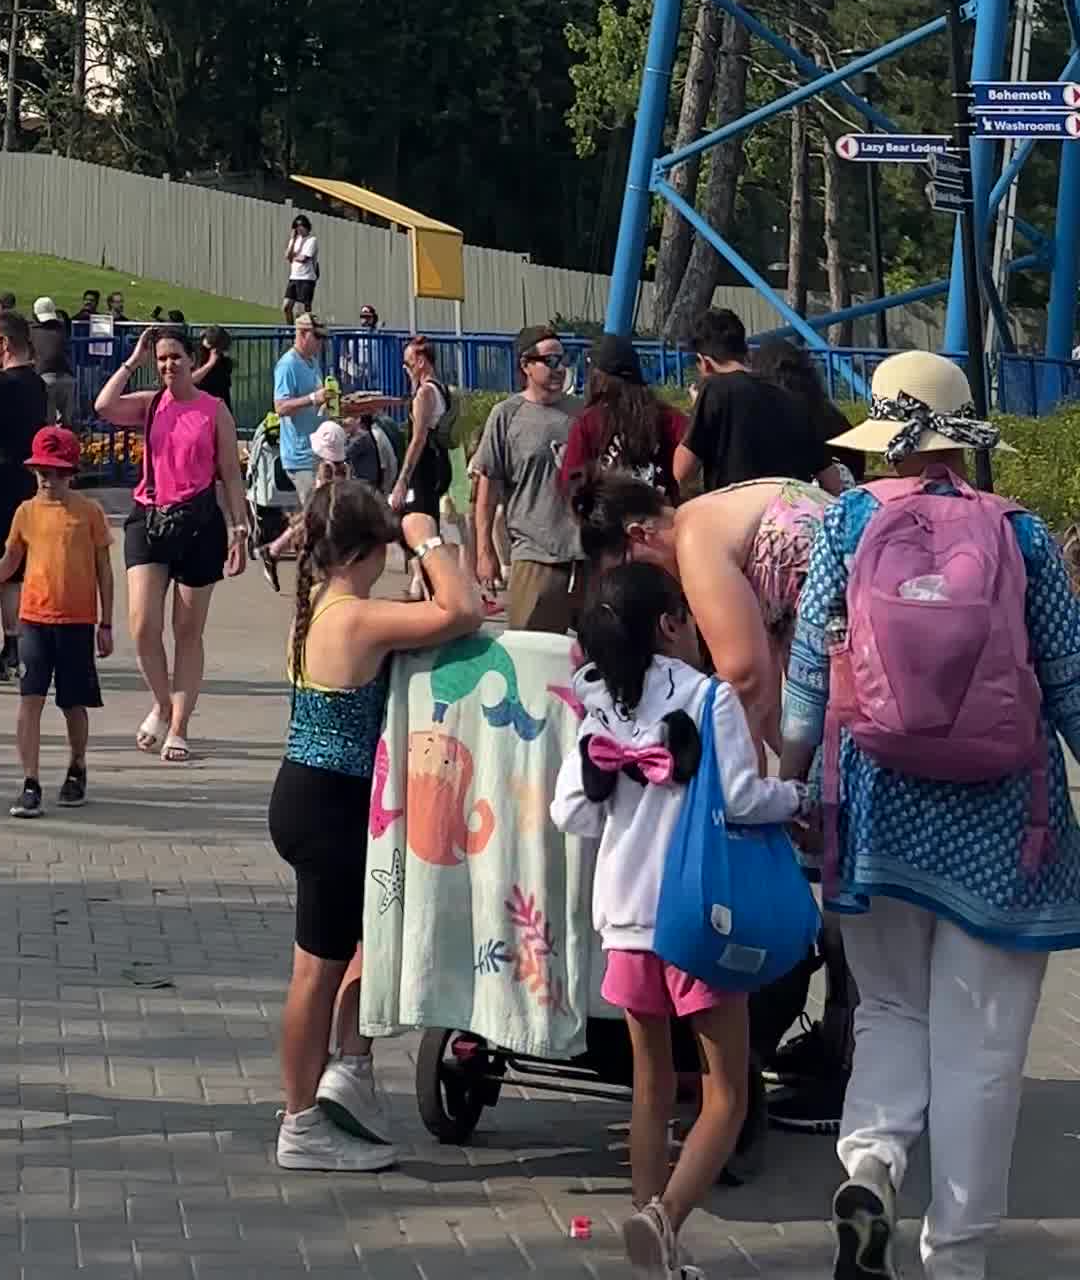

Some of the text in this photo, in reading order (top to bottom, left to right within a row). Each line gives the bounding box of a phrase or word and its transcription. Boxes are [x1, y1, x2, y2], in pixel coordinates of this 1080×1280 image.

[988, 90, 1052, 101] Behemoth
[994, 120, 1062, 131] Washrooms
[861, 142, 883, 154] Lazy
[885, 143, 910, 152] Bear
